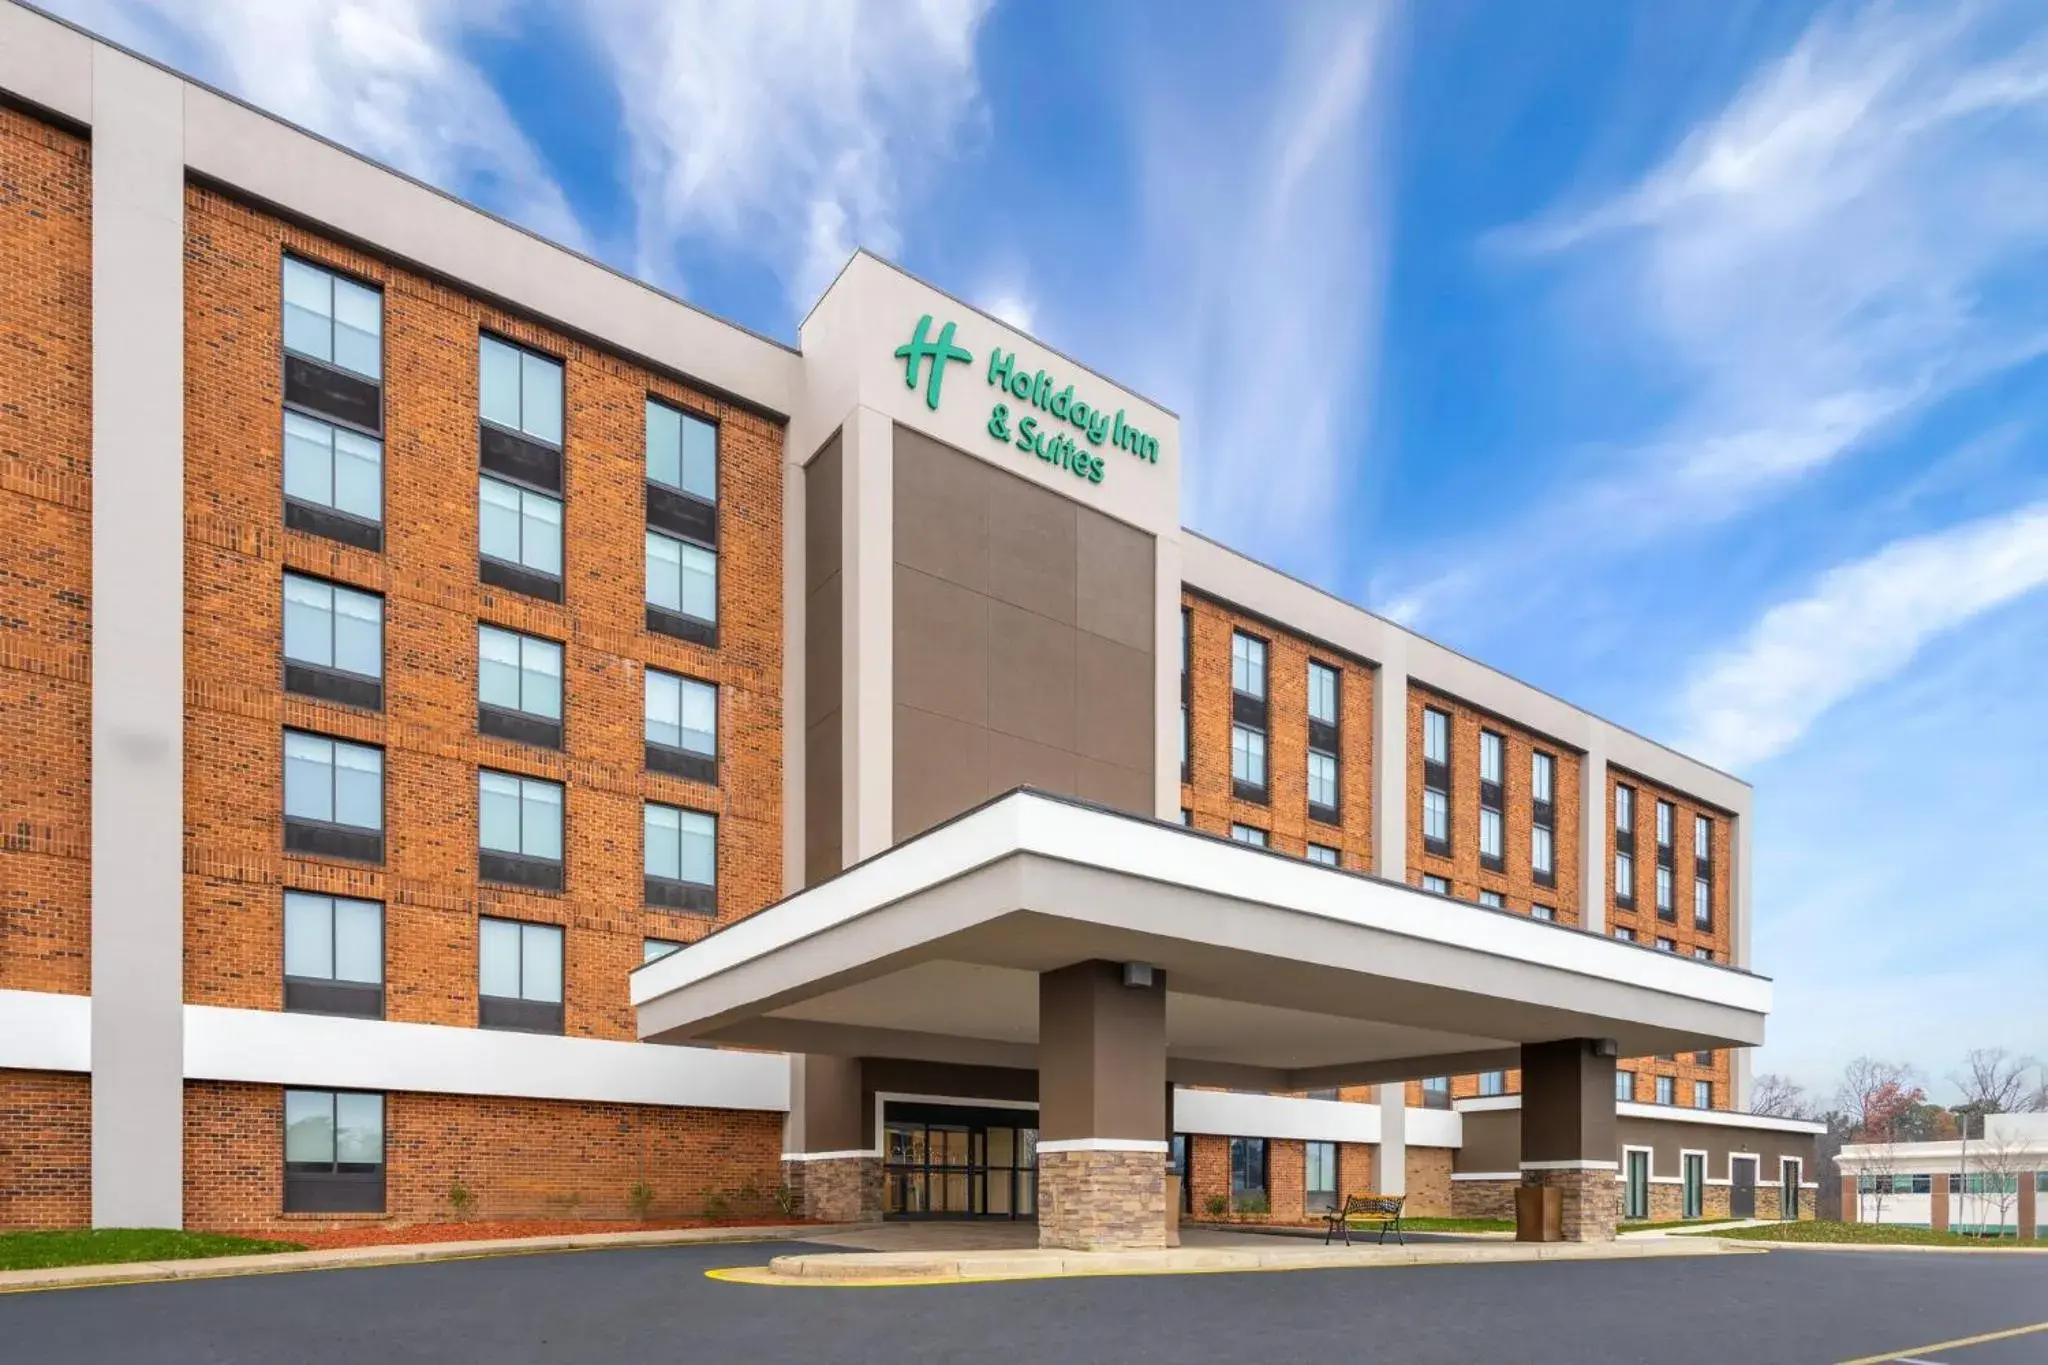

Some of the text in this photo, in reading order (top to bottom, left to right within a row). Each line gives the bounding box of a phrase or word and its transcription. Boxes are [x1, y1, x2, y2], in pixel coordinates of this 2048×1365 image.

[895, 314, 972, 410] H
[987, 347, 1160, 465] Holiday Inn
[987, 403, 1105, 484] & Suites
